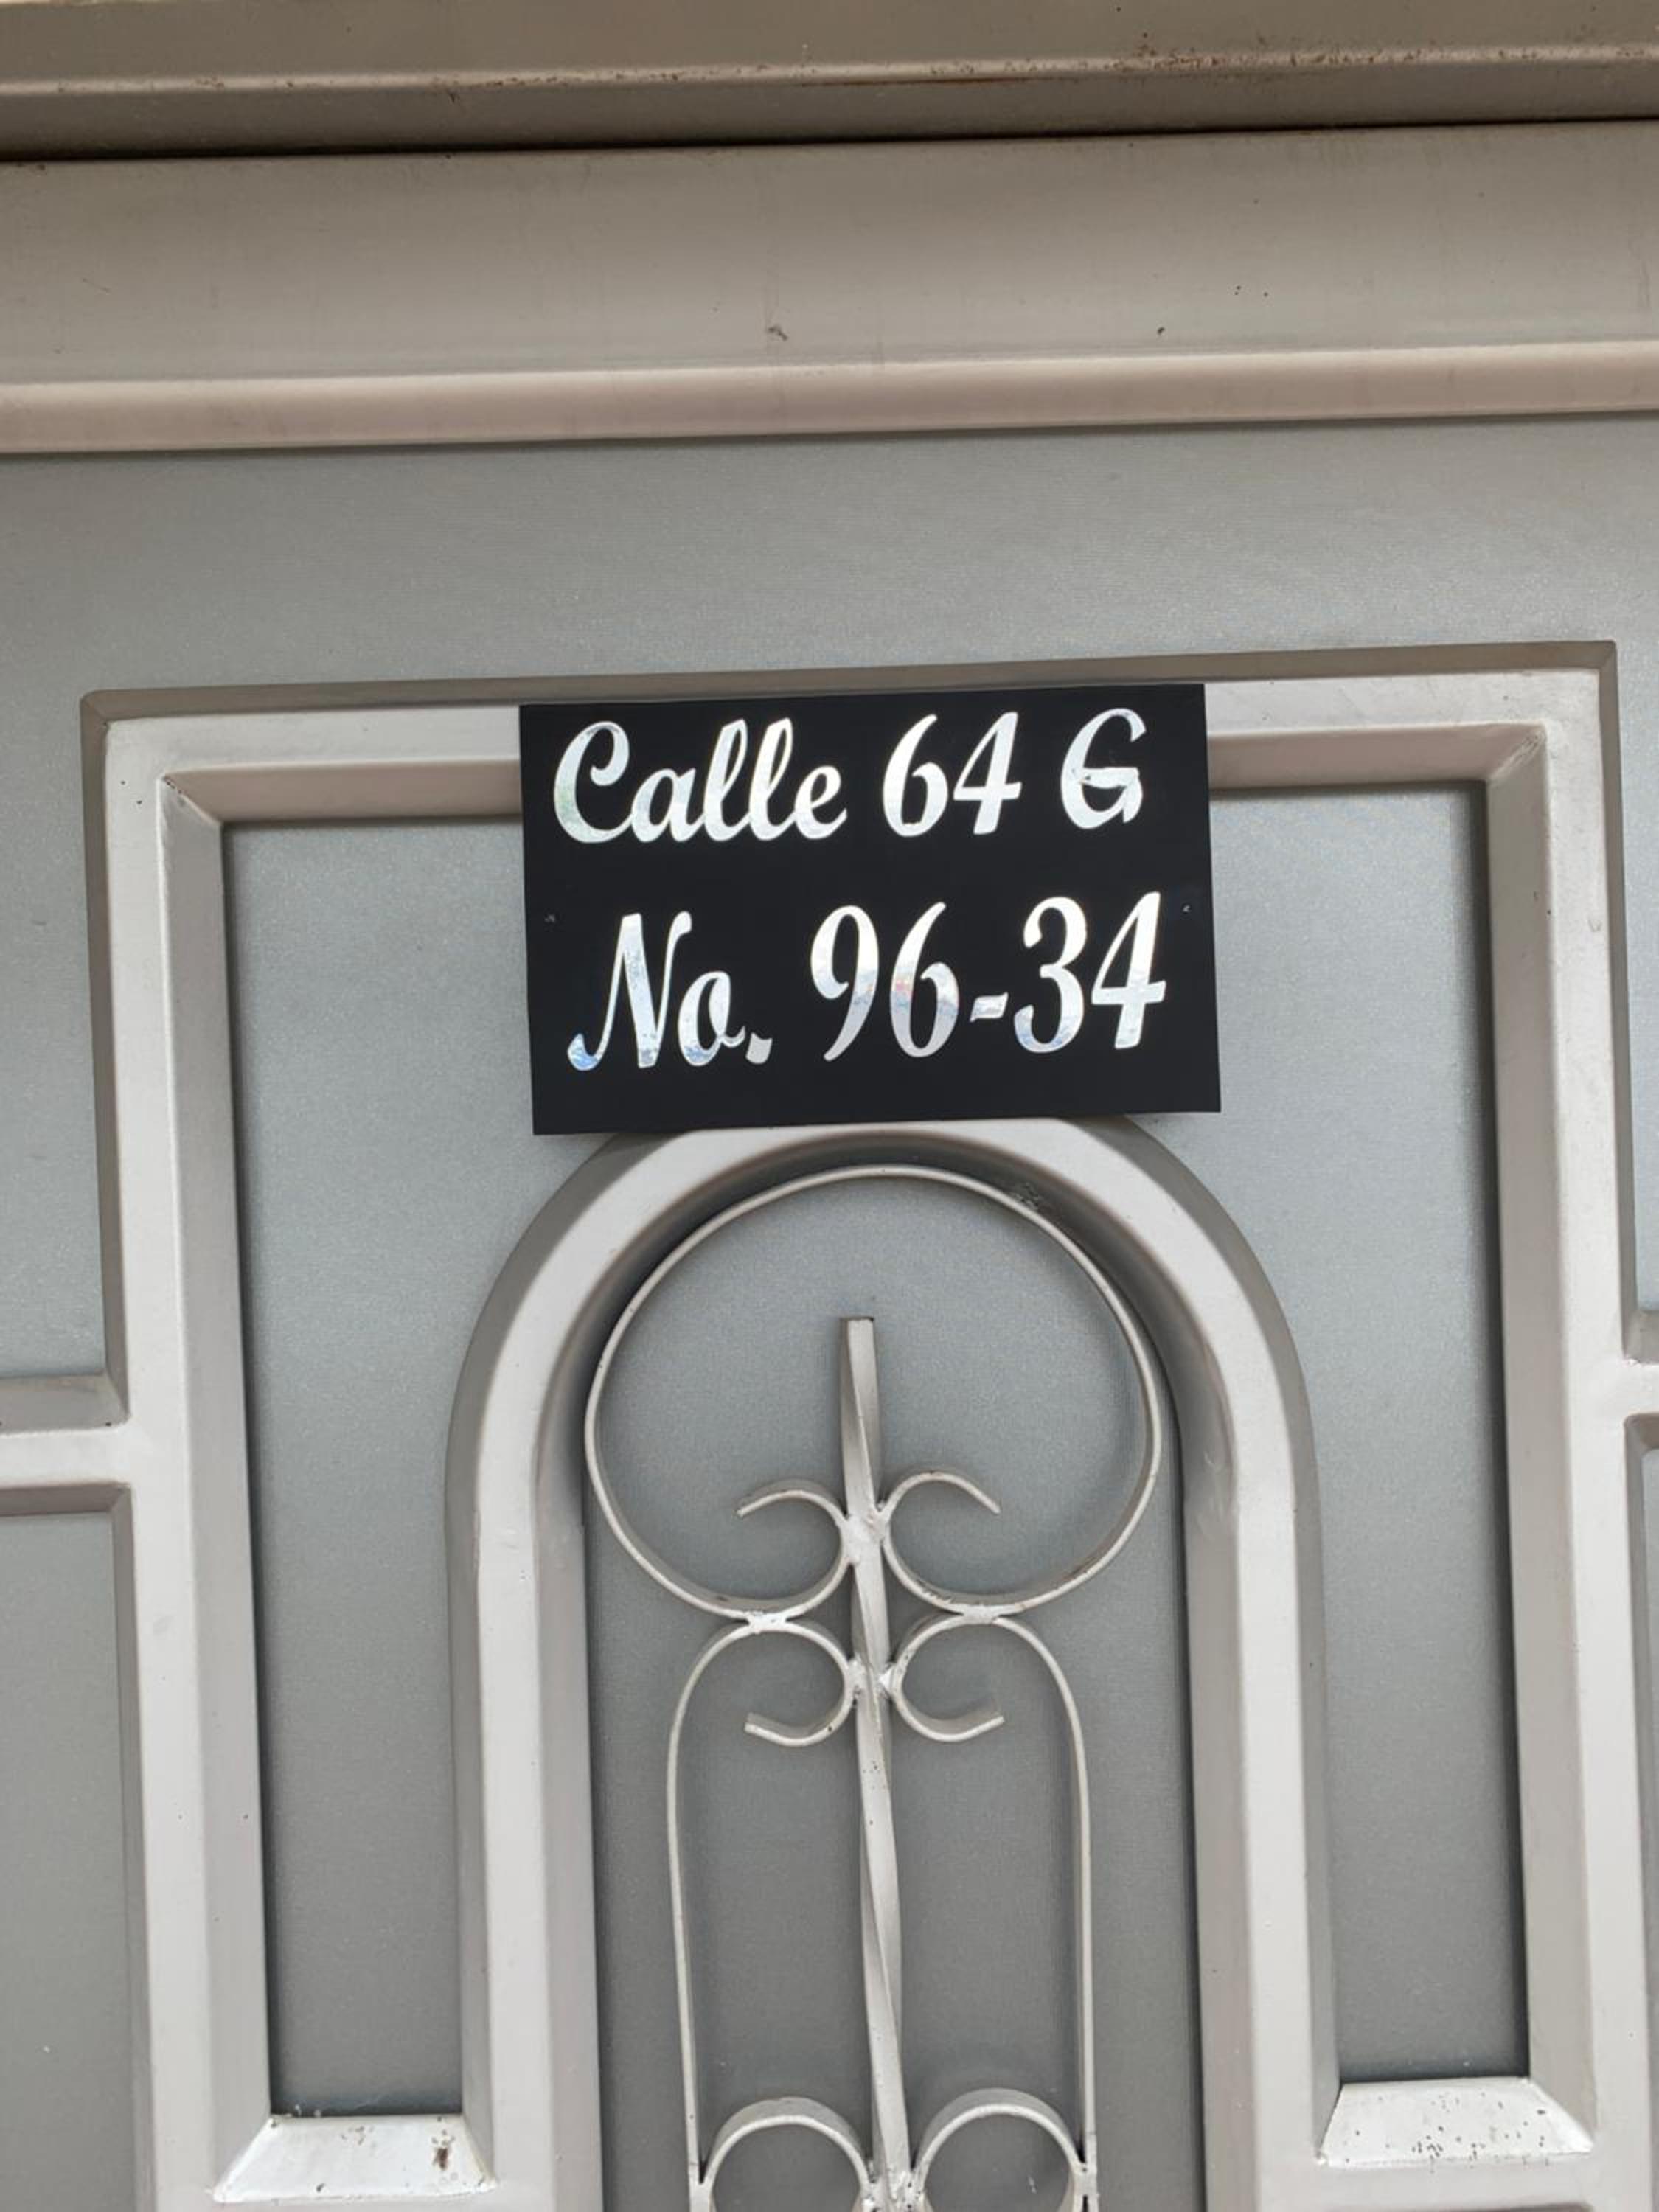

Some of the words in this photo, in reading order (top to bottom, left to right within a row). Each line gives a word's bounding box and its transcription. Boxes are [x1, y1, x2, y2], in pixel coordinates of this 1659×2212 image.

[553, 717, 848, 844] Calle
[882, 711, 1023, 838] 64
[1060, 707, 1147, 830] G
[567, 911, 773, 1071] No.
[810, 891, 1167, 1061] 96-34
